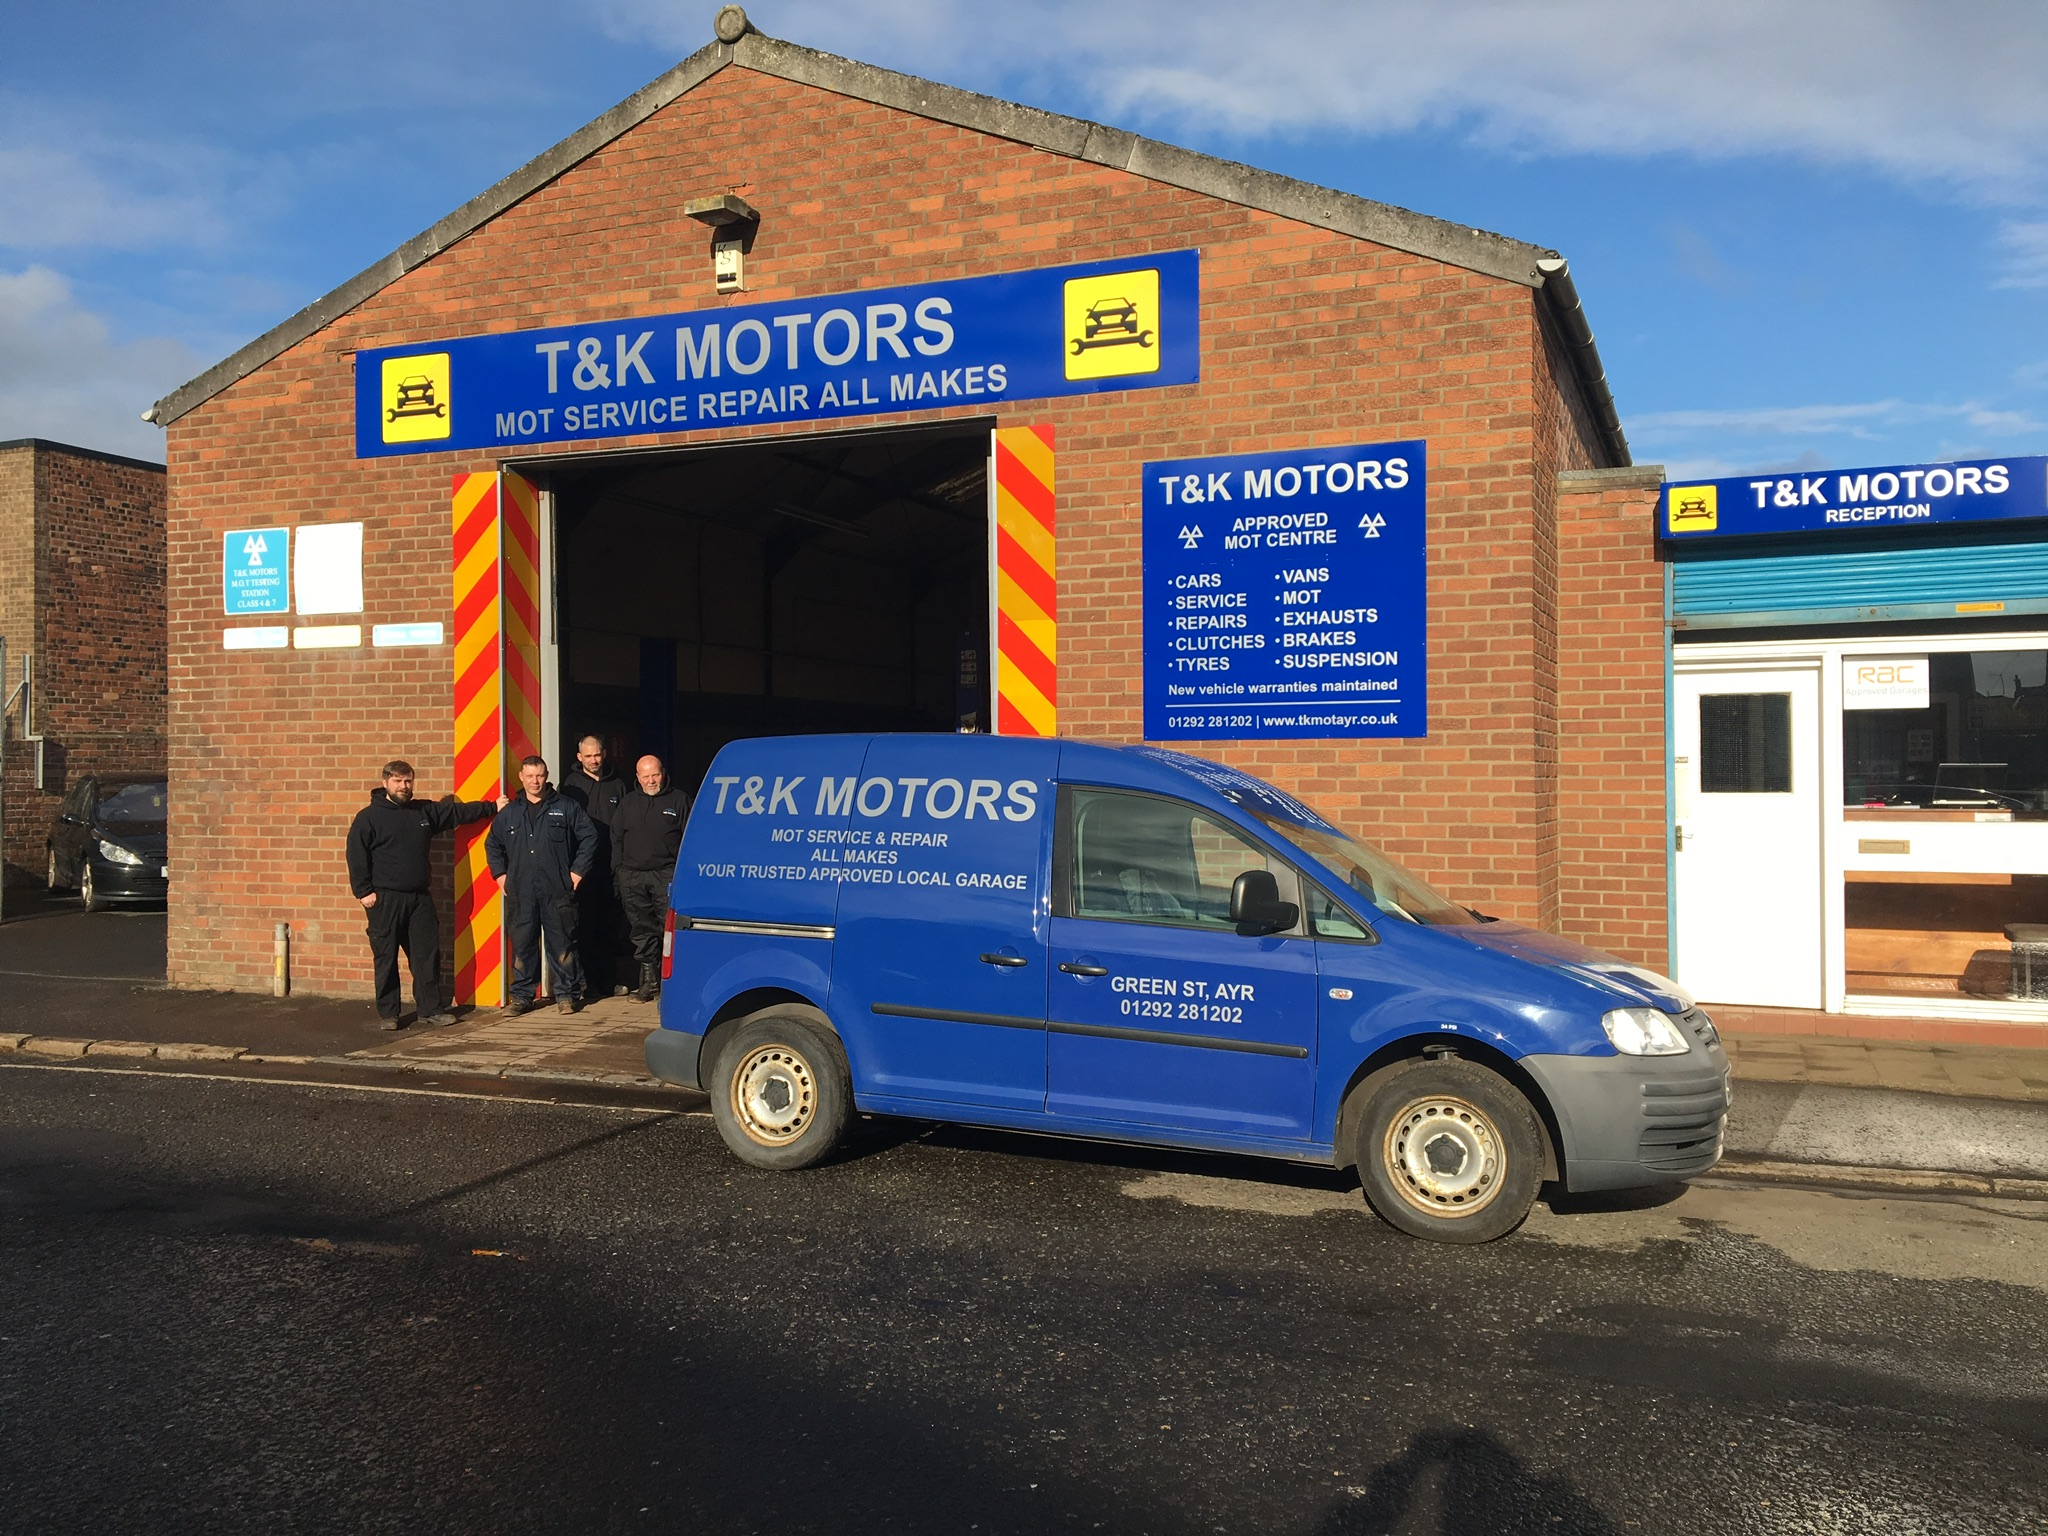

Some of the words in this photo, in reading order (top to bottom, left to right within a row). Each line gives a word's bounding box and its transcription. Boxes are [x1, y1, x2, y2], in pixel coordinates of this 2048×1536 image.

[535, 330, 656, 395] T&K
[676, 298, 953, 380] MOTORS
[496, 409, 554, 437] MOT
[564, 396, 687, 431] SERVICE
[699, 385, 809, 419] REPAIR
[819, 378, 879, 408] ALL
[891, 364, 1007, 401] MAKES
[1159, 472, 1232, 504] T&K
[1245, 458, 1408, 499] MOTORS
[1750, 478, 1827, 508] T&K
[1840, 465, 2009, 502] MOTORS
[1826, 504, 1930, 522] RECEPTION
[1233, 513, 1328, 531] APPROVED
[1225, 534, 1261, 549] MOT
[1267, 530, 1336, 547] CENTRE
[249, 568, 277, 576] MOTORS
[1283, 568, 1329, 583] VANS
[251, 578, 279, 586] TESTING
[1176, 574, 1221, 588] CARS
[241, 589, 269, 597] STATION
[1176, 593, 1246, 609] SERVICE
[1284, 590, 1321, 604] MOT
[238, 600, 259, 608] CLASS
[1176, 614, 1246, 630] REPAIRS
[1284, 609, 1378, 625] EXHAUSTS
[1176, 635, 1265, 650] CLUTCHES
[1284, 631, 1356, 647] BRAKES
[1176, 657, 1229, 671] TYRES
[1284, 651, 1397, 668] SUSPENSION
[1169, 685, 1195, 695] New
[1199, 683, 1244, 694] vehicle
[1248, 681, 1317, 693] warranties
[1322, 679, 1397, 691] maintained
[1846, 688, 1887, 696] Approved
[1890, 687, 1927, 695] Garages
[1169, 716, 1204, 727] 01292
[1209, 716, 1252, 727] 281202
[1264, 713, 1398, 727] www.tkmotayr.co.uk
[714, 776, 805, 815] T&K
[815, 777, 1037, 821] MOTORS
[772, 829, 804, 842] MOT
[807, 830, 871, 844] SERVICE
[876, 832, 885, 844] &
[891, 832, 948, 847] REPAIR
[811, 849, 839, 862] ALL
[844, 850, 897, 864] MAKES
[698, 864, 735, 877] YOUR
[740, 865, 806, 879] TRUSTED
[809, 868, 893, 884] APPROVED
[898, 871, 950, 886] LOCAL
[956, 873, 1027, 889] GARAGE
[1112, 977, 1176, 995] GREEN
[1183, 981, 1209, 1000] ST,
[1215, 984, 1254, 1001] AYR
[1121, 999, 1172, 1017] 01292
[1178, 1003, 1242, 1023] 281202
